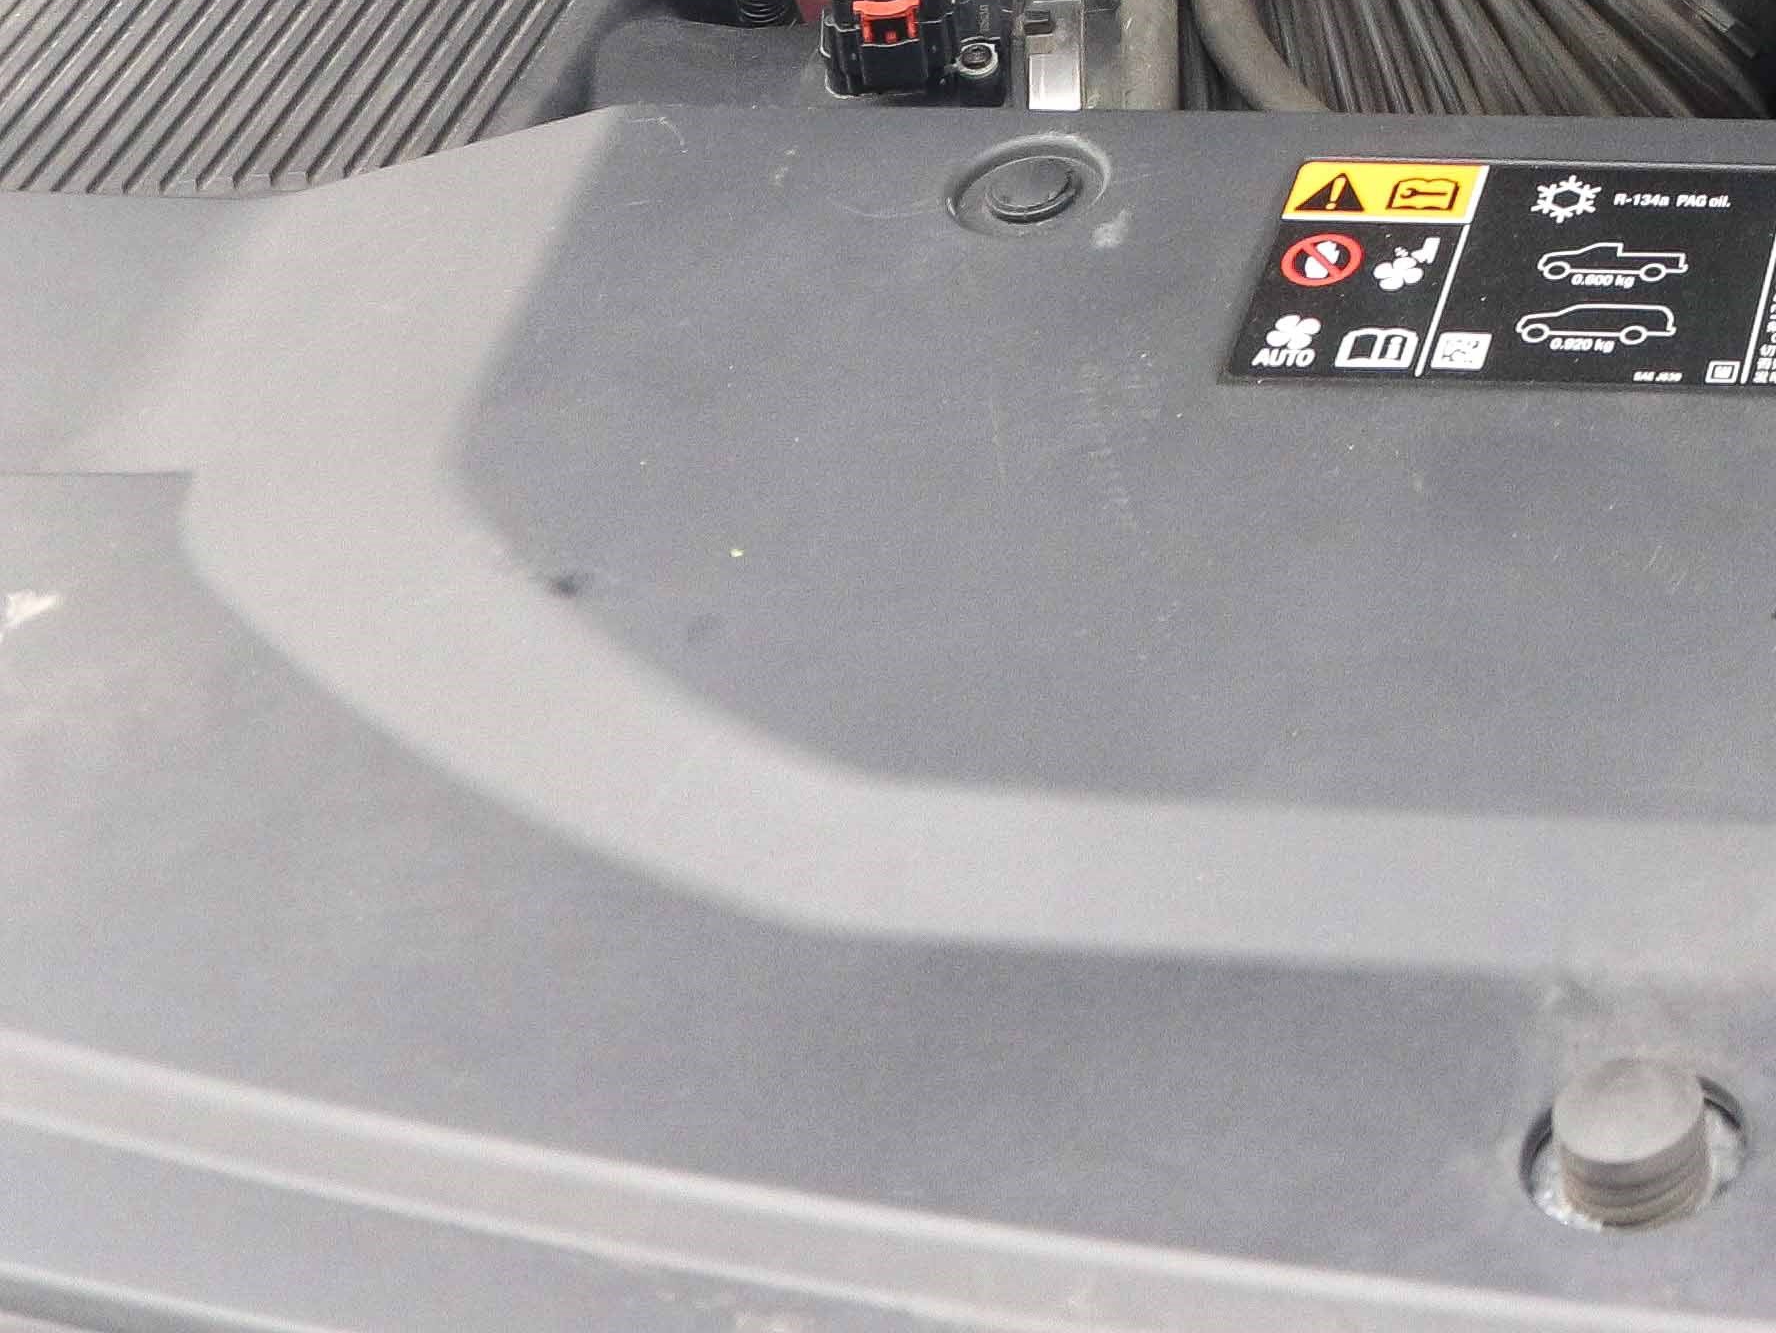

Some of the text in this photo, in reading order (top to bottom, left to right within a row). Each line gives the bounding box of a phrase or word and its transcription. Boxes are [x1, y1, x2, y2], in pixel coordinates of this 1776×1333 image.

[1613, 193, 1732, 208] R-134a PAG oil.
[1615, 274, 1635, 289] kg
[1594, 338, 1615, 353] kg
[1251, 347, 1317, 368] AUTO
